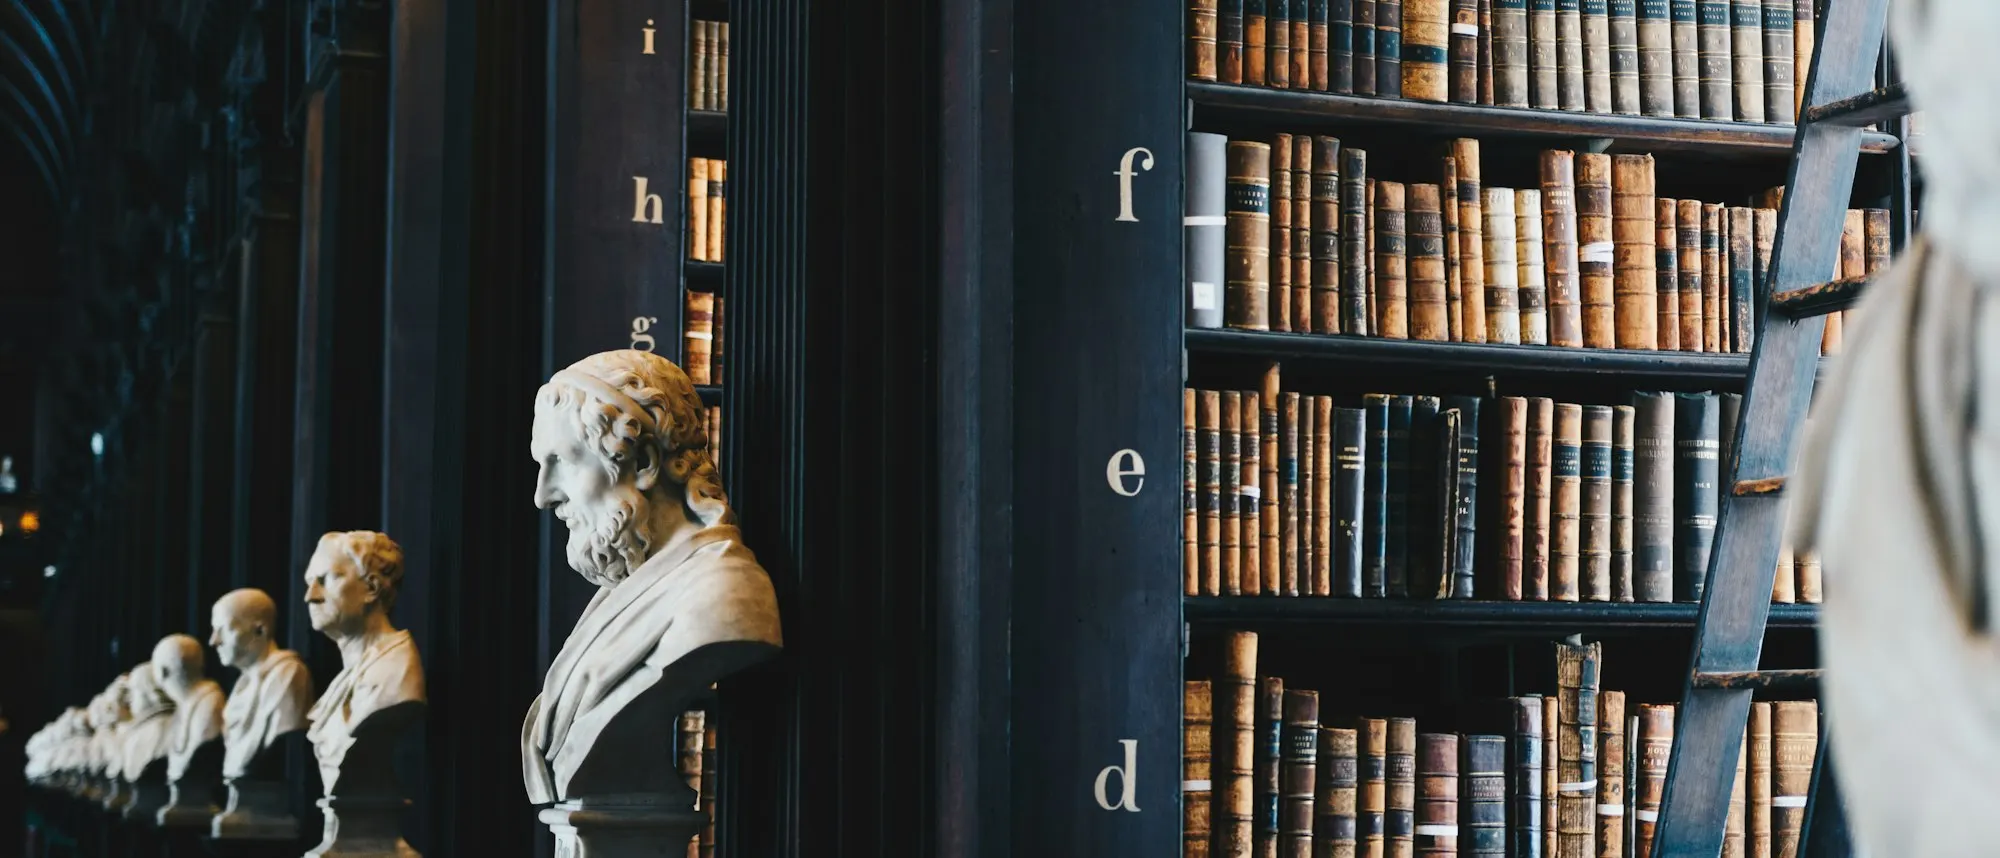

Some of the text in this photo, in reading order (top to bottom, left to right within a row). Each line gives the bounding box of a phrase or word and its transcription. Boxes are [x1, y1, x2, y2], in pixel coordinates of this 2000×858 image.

[642, 19, 656, 54] i
[632, 176, 663, 224] h
[1113, 147, 1154, 222] f
[631, 316, 657, 351] g
[1106, 448, 1145, 497] e
[1095, 739, 1141, 812] d
